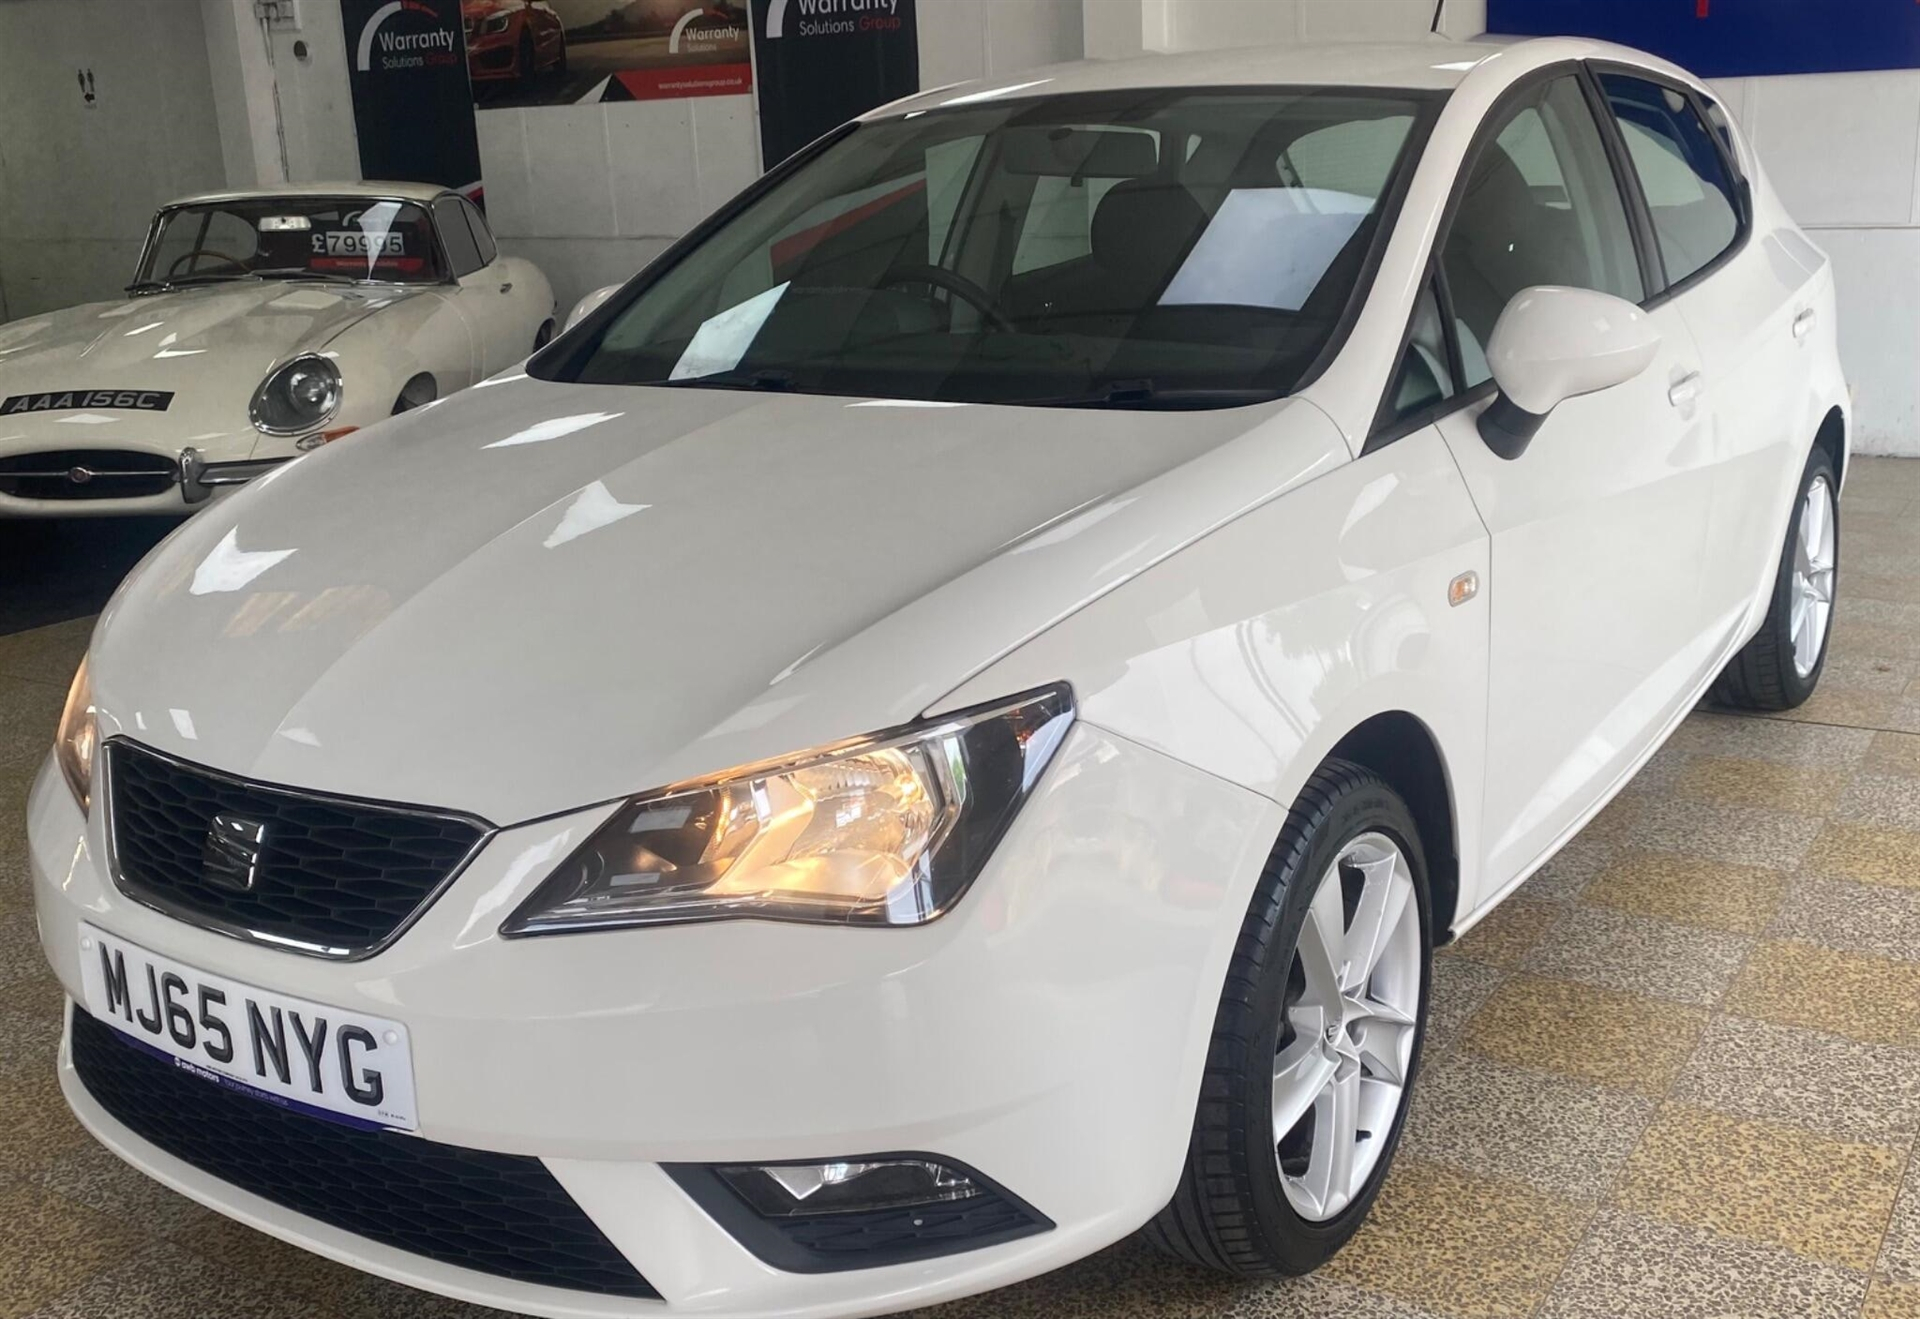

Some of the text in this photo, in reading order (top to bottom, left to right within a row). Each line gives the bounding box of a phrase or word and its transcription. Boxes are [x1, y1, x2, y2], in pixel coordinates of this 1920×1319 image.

[685, 25, 739, 42] Warranty
[799, 15, 901, 36] Solutions Group
[379, 28, 454, 52] Warranty
[687, 43, 717, 53] Solutions
[382, 55, 424, 70] Solutions
[9, 391, 161, 412] AAA 156C
[98, 940, 384, 1107] MJ65 NYG
